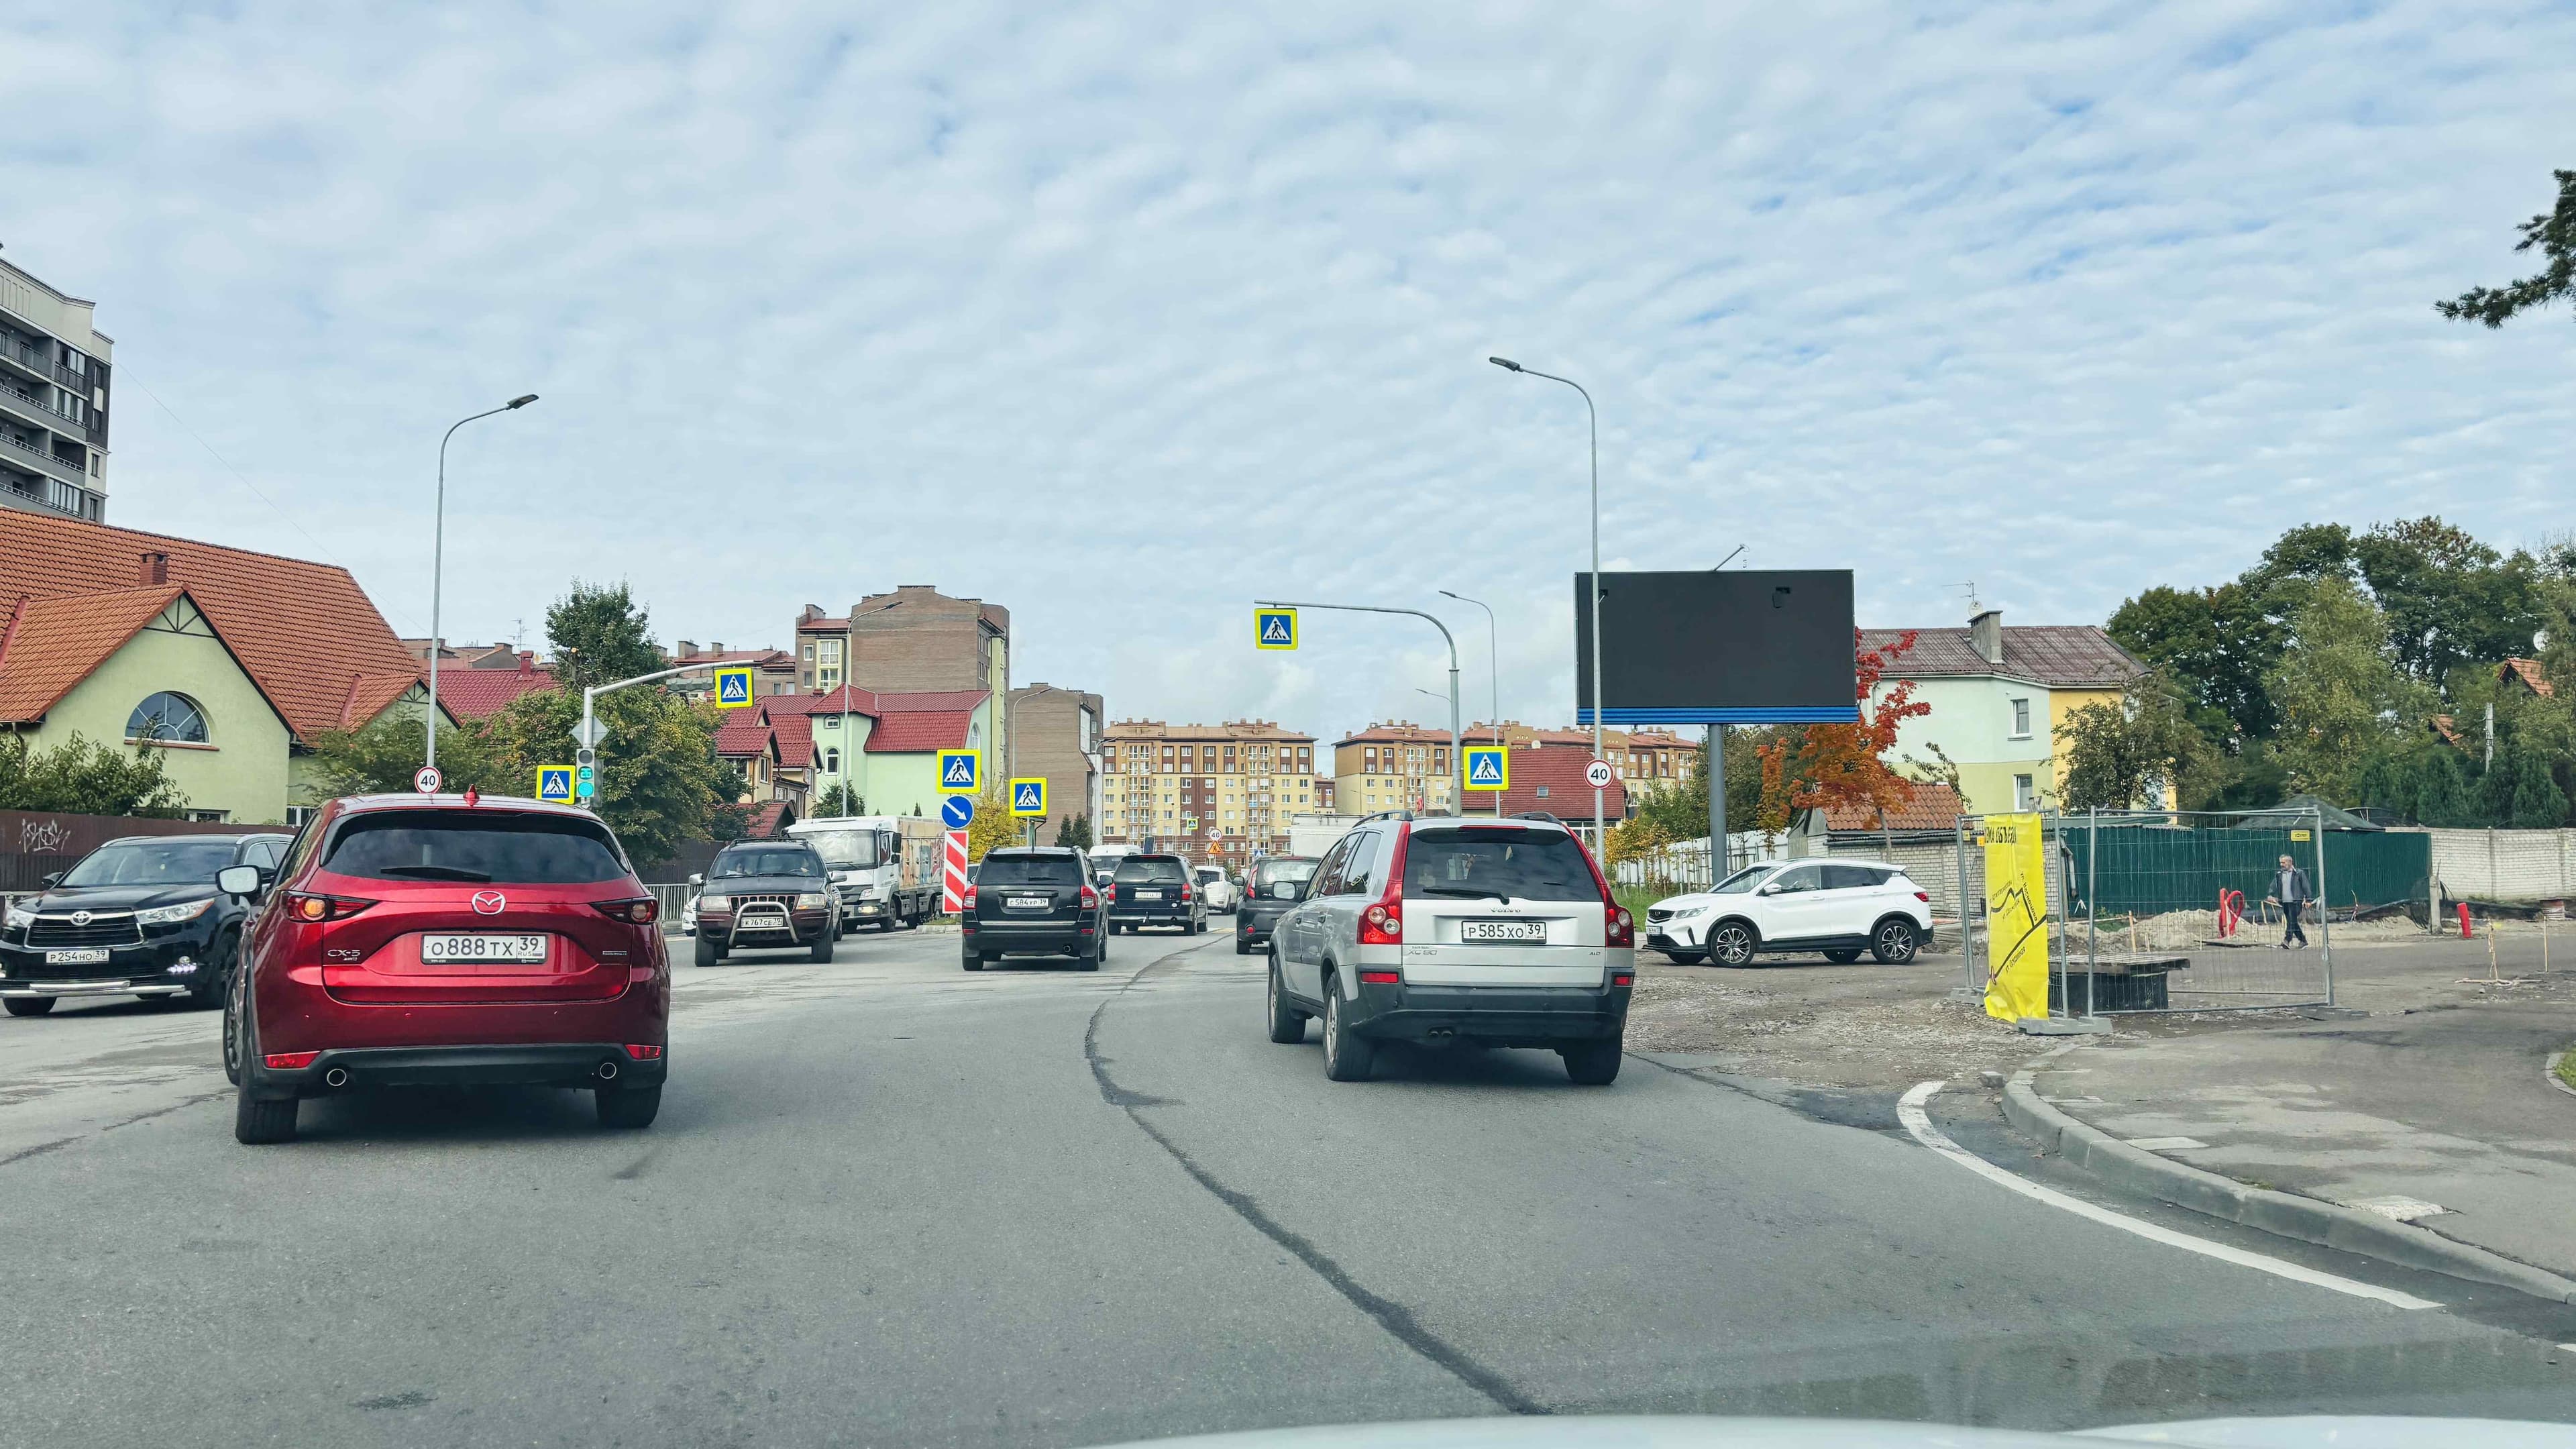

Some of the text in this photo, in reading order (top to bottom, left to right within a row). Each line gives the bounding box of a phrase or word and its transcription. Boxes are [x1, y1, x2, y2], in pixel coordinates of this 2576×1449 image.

[1591, 768, 1607, 780] 40
[421, 775, 435, 786] 40
[519, 938, 539, 951] 39
